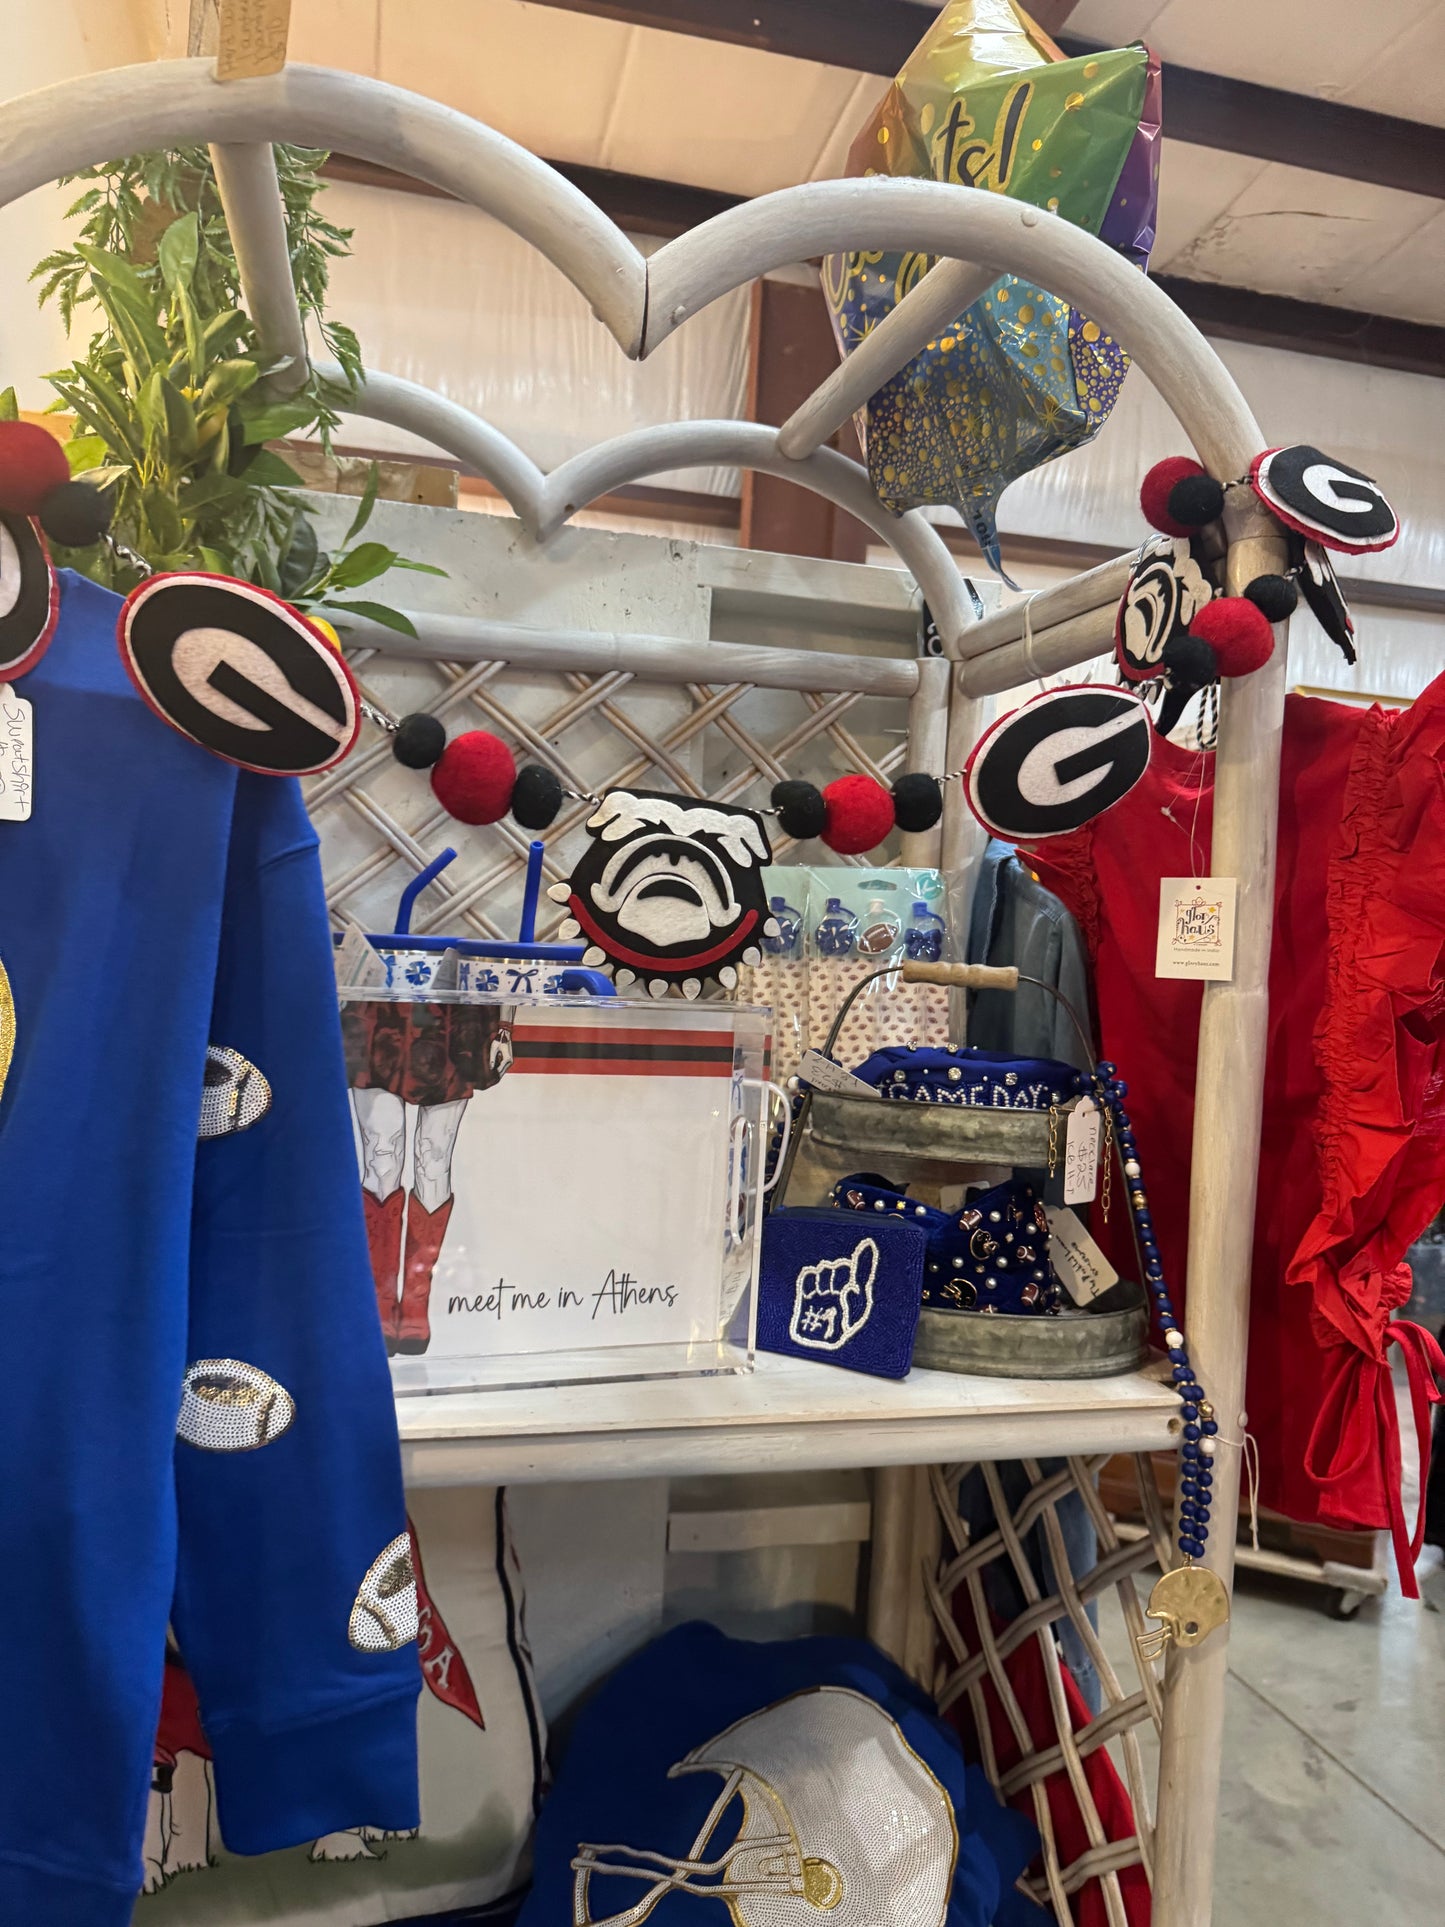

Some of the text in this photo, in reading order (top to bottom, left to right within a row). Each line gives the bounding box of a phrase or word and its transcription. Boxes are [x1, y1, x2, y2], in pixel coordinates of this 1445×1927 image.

[130, 584, 348, 771] G
[977, 694, 1150, 834] G
[1176, 917, 1216, 936] haus
[448, 1268, 679, 1320] meet me in Athens
[801, 1305, 838, 1340] #1
